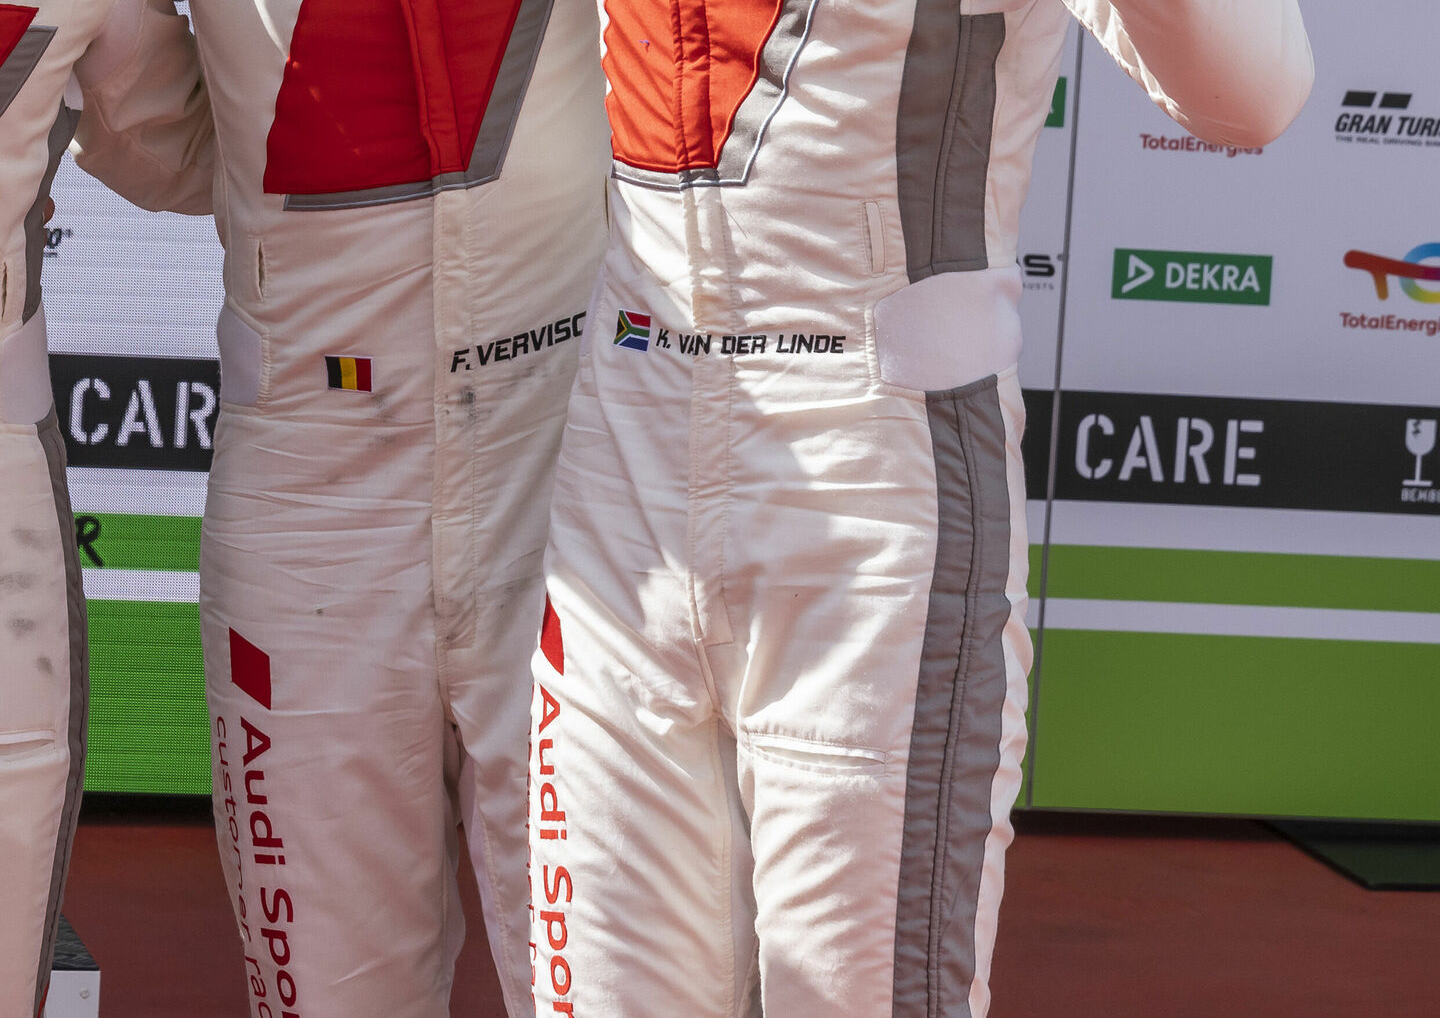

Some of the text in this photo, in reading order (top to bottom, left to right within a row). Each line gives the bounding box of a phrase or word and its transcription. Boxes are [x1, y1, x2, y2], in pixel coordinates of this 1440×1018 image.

[1334, 112, 1392, 134] GRAN
[1164, 261, 1261, 293] DEKRA
[678, 333, 711, 356] VAN
[720, 334, 767, 355] DER
[775, 334, 847, 355] LINDE
[1075, 412, 1265, 487] CARE
[240, 715, 286, 866] Audi
[538, 682, 568, 841] Audi
[216, 714, 252, 943] customer
